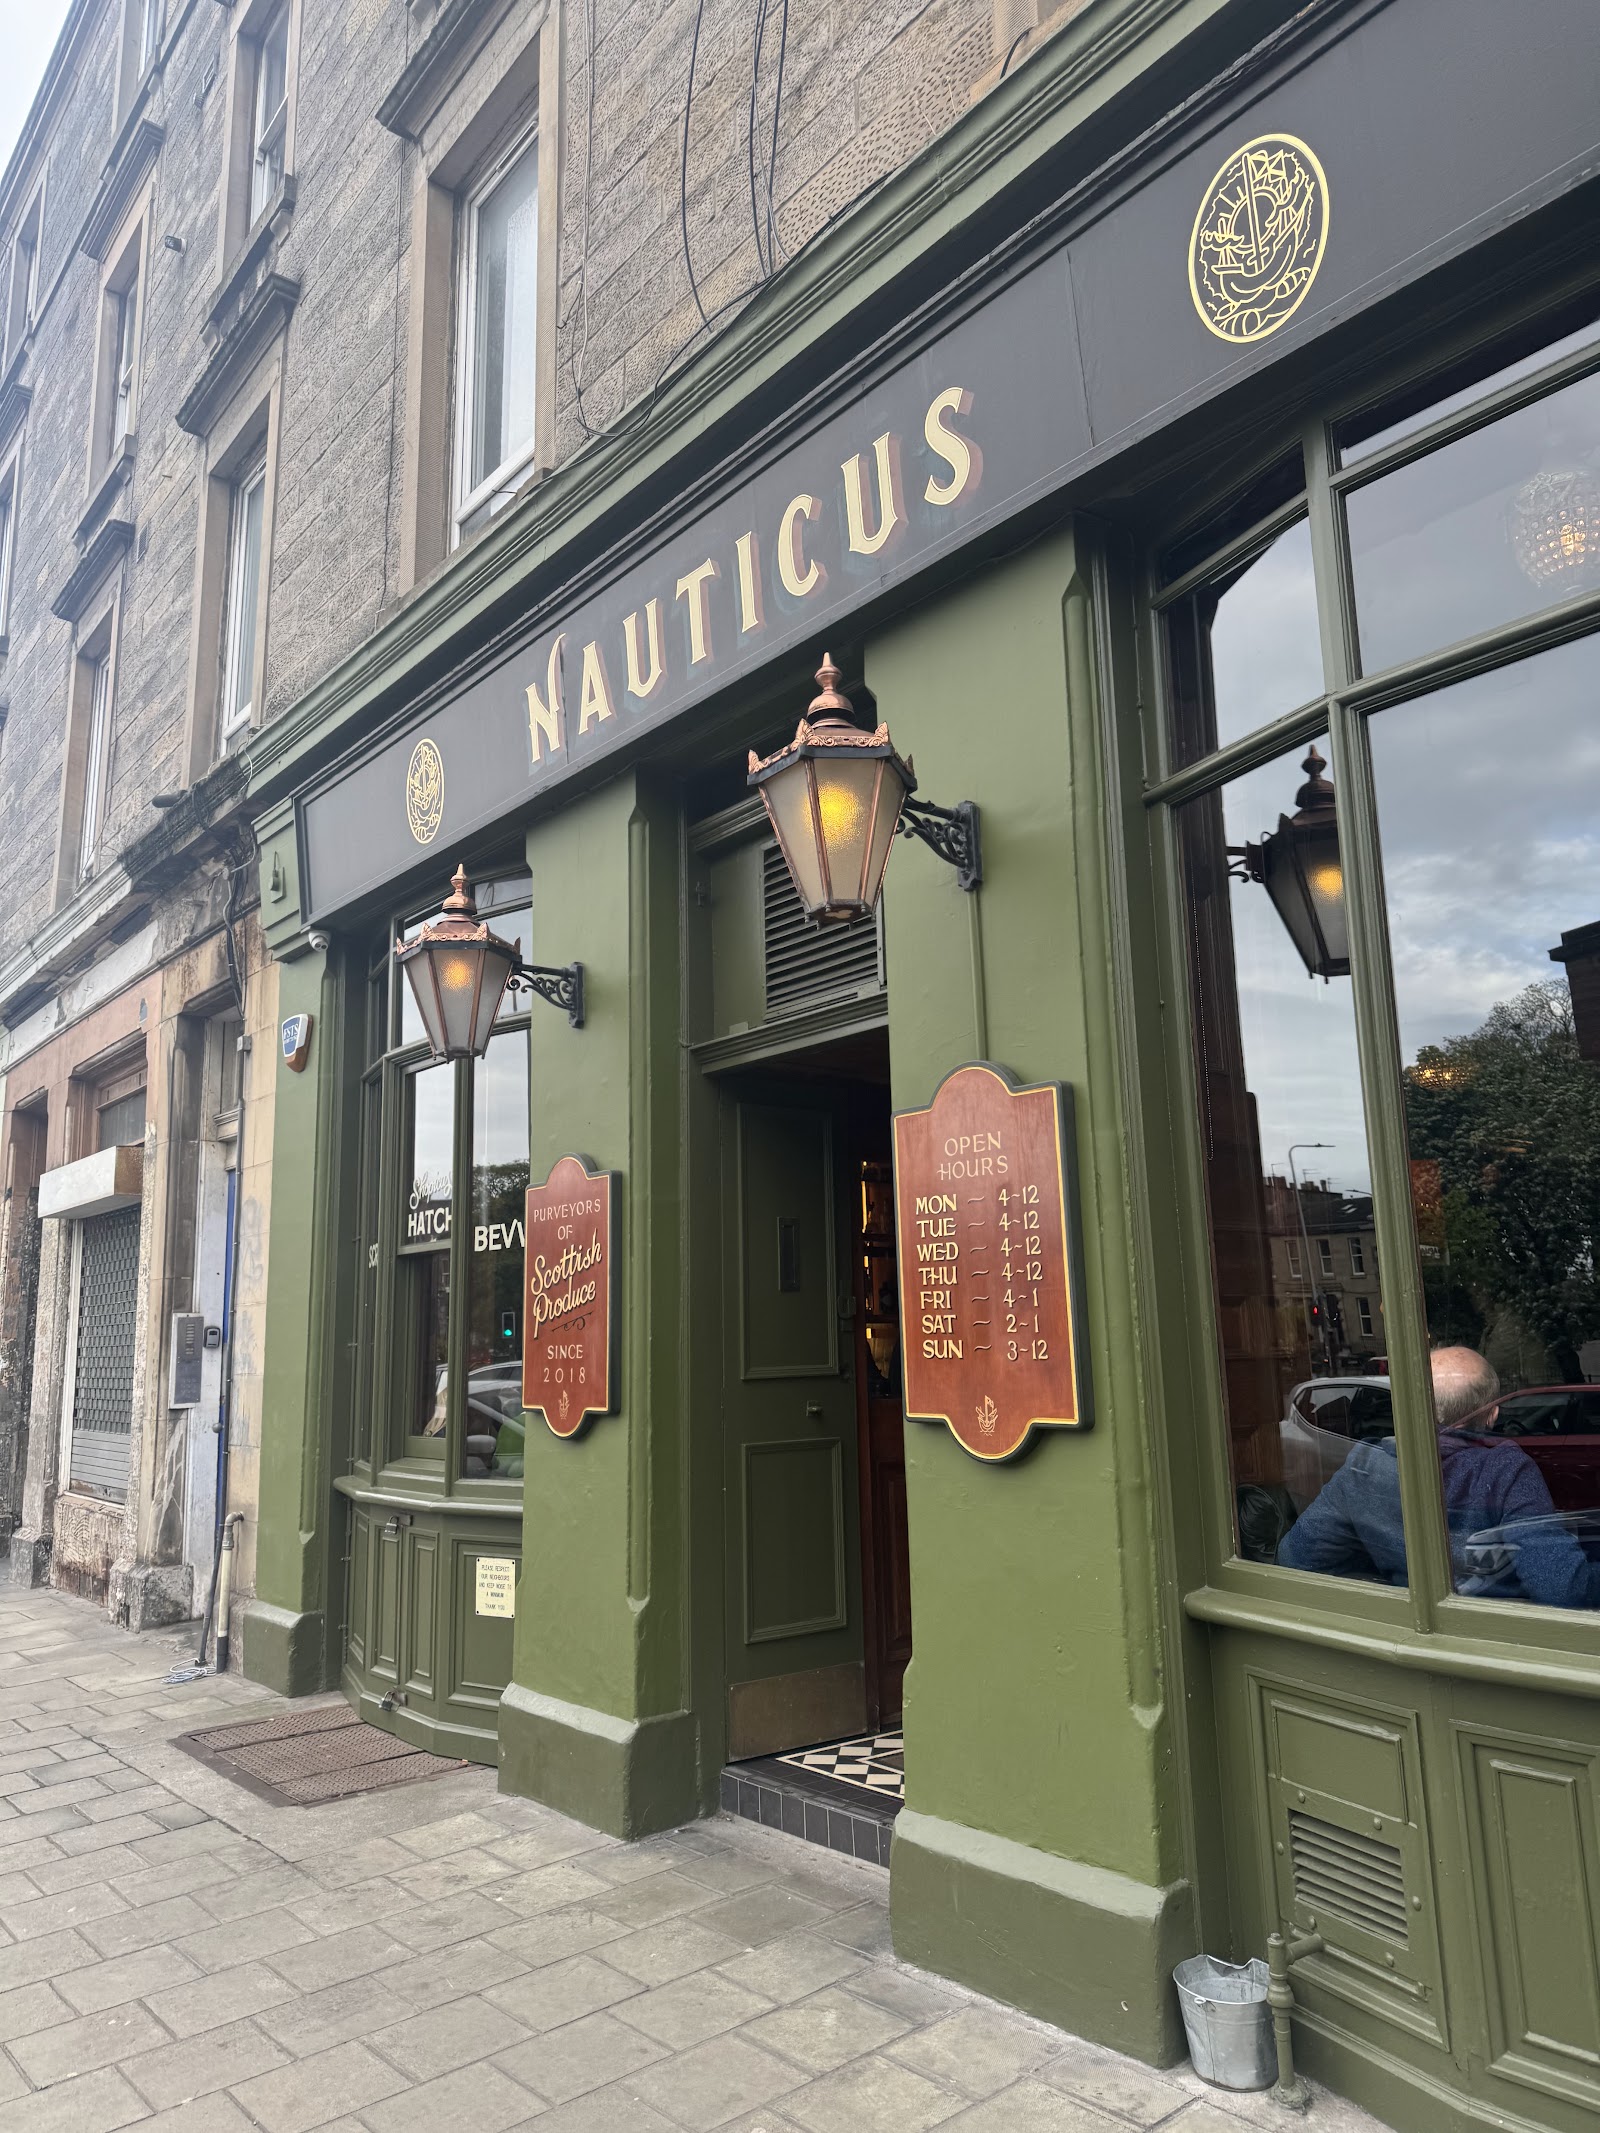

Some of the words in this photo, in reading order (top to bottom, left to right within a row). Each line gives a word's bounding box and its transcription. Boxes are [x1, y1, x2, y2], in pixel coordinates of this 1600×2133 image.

[525, 387, 972, 763] NAUTICUS
[944, 1131, 1002, 1157] OPEN
[937, 1155, 1009, 1181] HOURS
[533, 1198, 602, 1223] PURVEYORS
[915, 1194, 958, 1216] MON
[557, 1224, 573, 1241] OF
[916, 1217, 958, 1238] TUE
[531, 1228, 602, 1295] Scottish
[916, 1242, 960, 1262] WED
[918, 1265, 958, 1286] THU
[533, 1276, 597, 1339] Produce
[920, 1290, 952, 1310] FRI
[921, 1314, 957, 1334] SAT
[547, 1344, 584, 1360] SINCE
[922, 1339, 964, 1359] SUN
[543, 1367, 586, 1384] 2018
